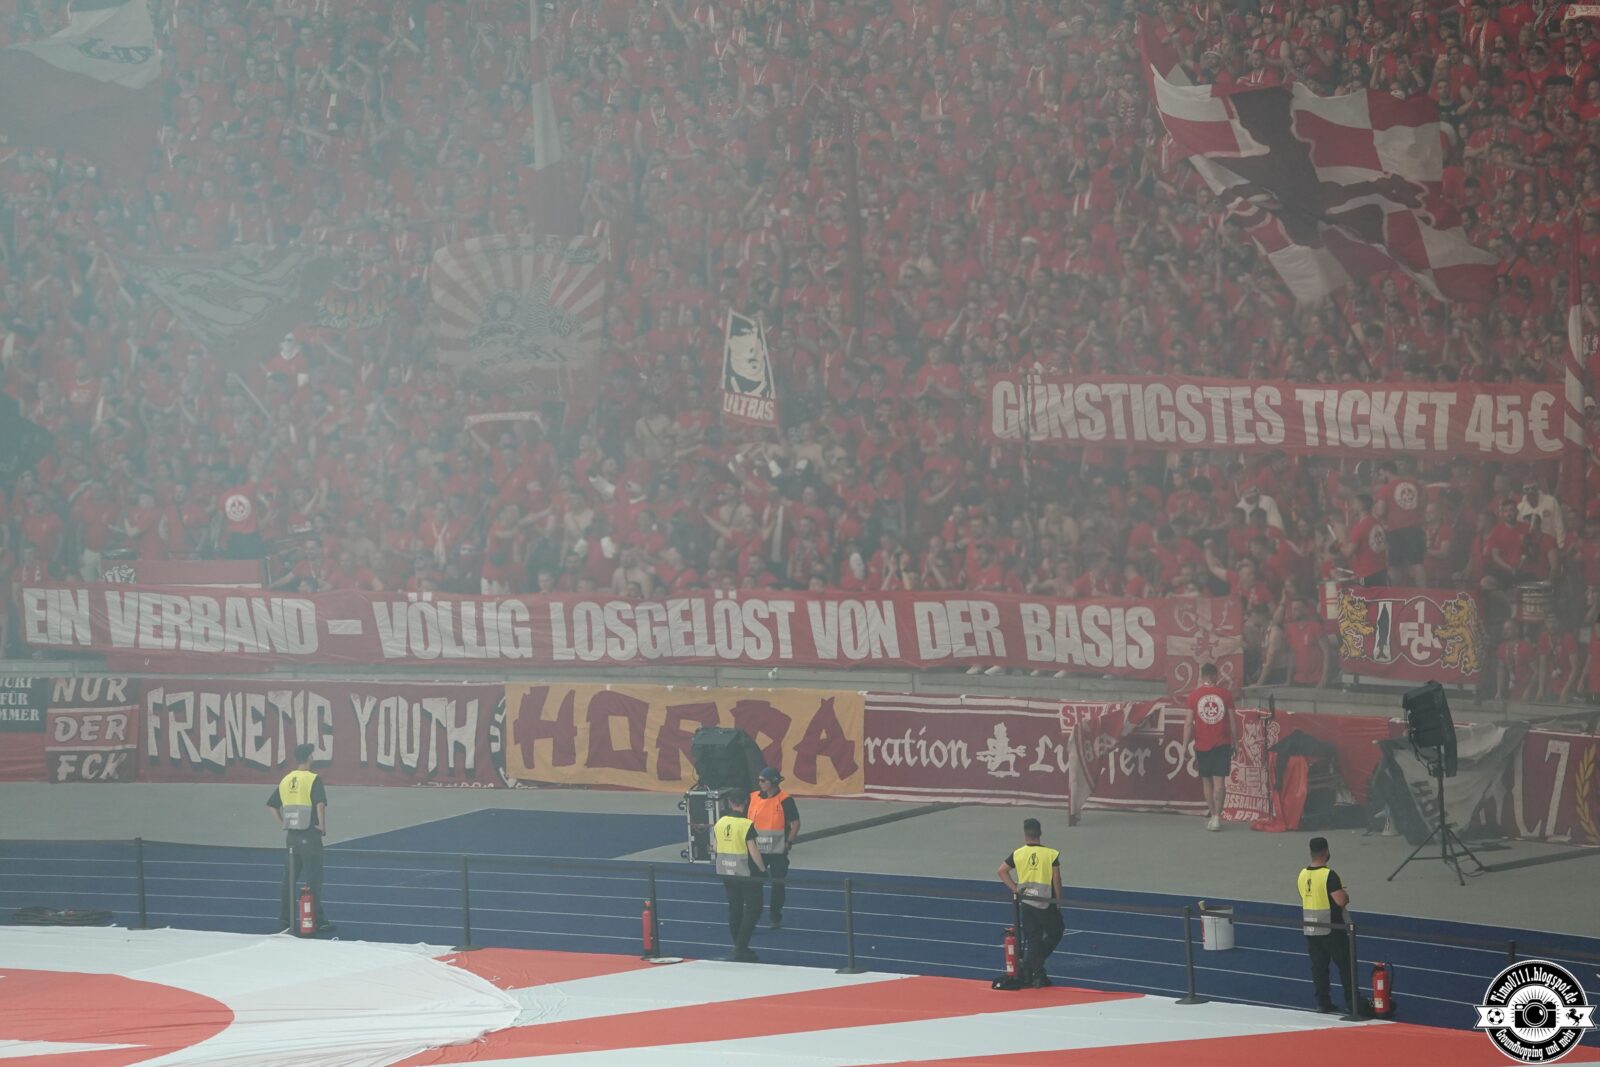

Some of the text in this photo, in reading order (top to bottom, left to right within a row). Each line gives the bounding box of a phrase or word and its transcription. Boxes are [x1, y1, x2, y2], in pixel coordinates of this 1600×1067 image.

[723, 391, 775, 421] ULTRAS
[992, 375, 1564, 454] GÜNSTIGSTES TICKET 45€
[23, 589, 91, 645] EIN
[106, 591, 319, 655] VERBAND
[373, 592, 533, 660] VÖLLIG
[549, 589, 795, 661] LOSGELÖST
[807, 599, 901, 659] VON
[915, 600, 1006, 659] DER
[1020, 603, 1155, 670] BASIS
[52, 677, 128, 703] NUR
[54, 714, 128, 742] DER
[350, 693, 479, 773] YOUTH
[57, 753, 128, 781] FCK
